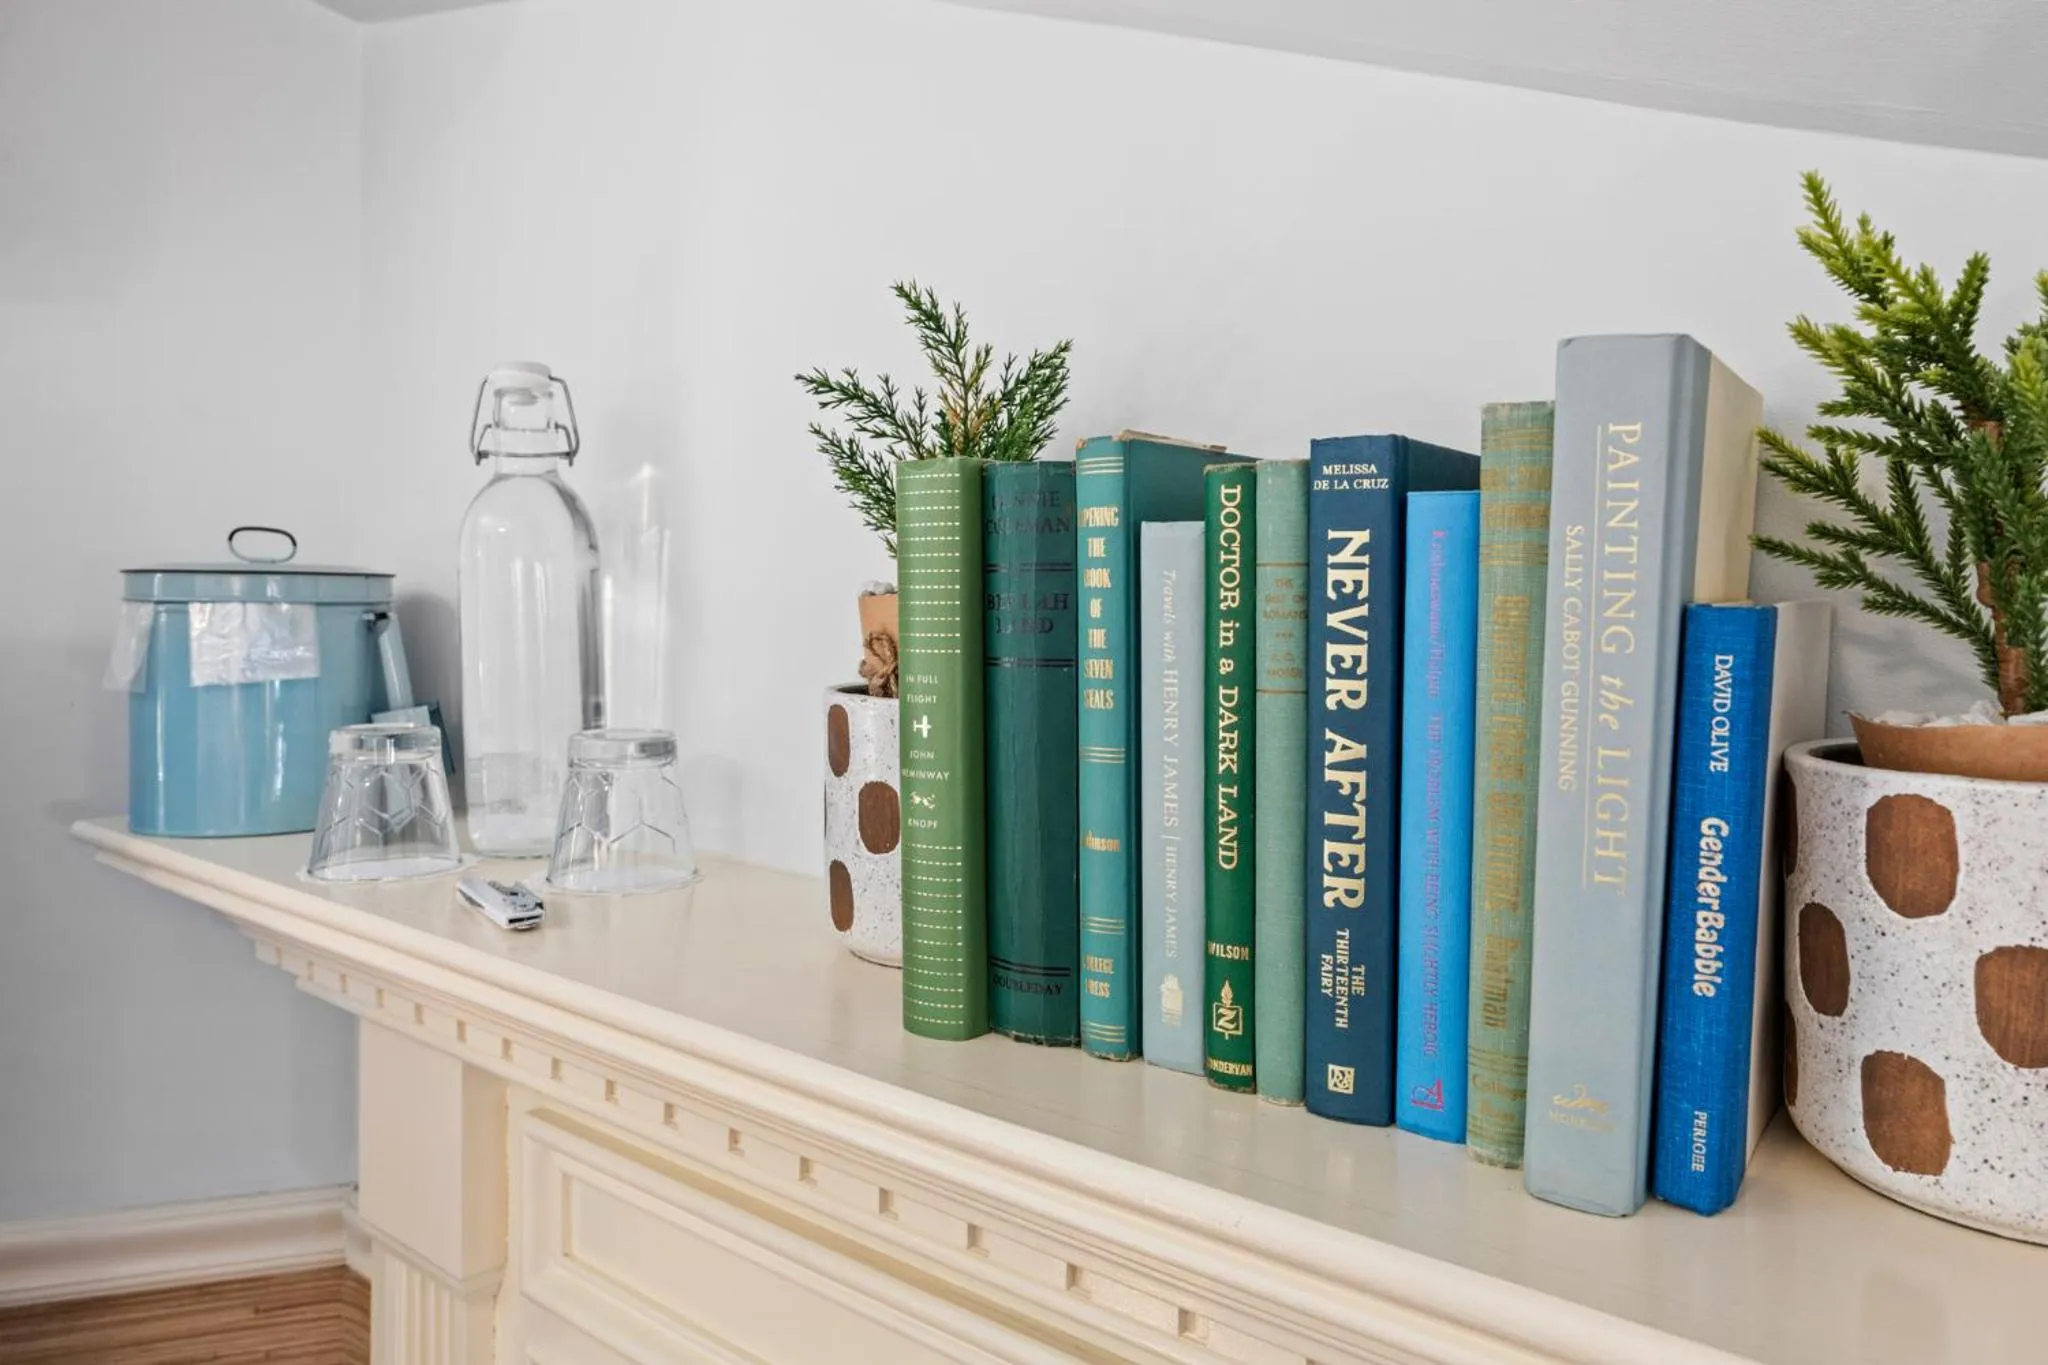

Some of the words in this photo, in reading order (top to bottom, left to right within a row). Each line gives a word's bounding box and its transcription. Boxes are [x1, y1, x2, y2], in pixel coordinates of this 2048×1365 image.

[1313, 480, 1329, 491] DE
[1334, 479, 1350, 491] LA
[1353, 478, 1390, 490] CRUZ
[1322, 463, 1378, 476] MELISSA
[1087, 536, 1106, 558] THE
[1219, 484, 1242, 610] DOCTOR
[1563, 524, 1585, 592] SALLY
[1600, 420, 1642, 656] PAINTING
[1089, 597, 1103, 619] OF
[1162, 568, 1180, 626] Travels
[1324, 528, 1371, 711] NEVER
[1087, 627, 1107, 650] THE
[1218, 656, 1236, 675] a
[1219, 619, 1240, 647] in
[1561, 596, 1582, 677] CABOT
[1161, 667, 1180, 748] HENRY
[1597, 673, 1633, 731] the
[1711, 654, 1734, 713] DAVID
[1218, 684, 1239, 775] DARK
[1556, 681, 1579, 792] GUNNING
[1709, 715, 1730, 773] OLIVE
[1160, 753, 1180, 828] JAMES
[1322, 728, 1368, 909] AFTER
[1592, 746, 1630, 897] LIGHT
[1217, 782, 1238, 870] LAND
[1691, 816, 1730, 999] GenderBabble
[1320, 953, 1334, 998] FAIRY
[1335, 927, 1350, 1029] THIRTEENTH
[1351, 963, 1366, 997] THE
[1690, 1110, 1708, 1174] PERIGEE
